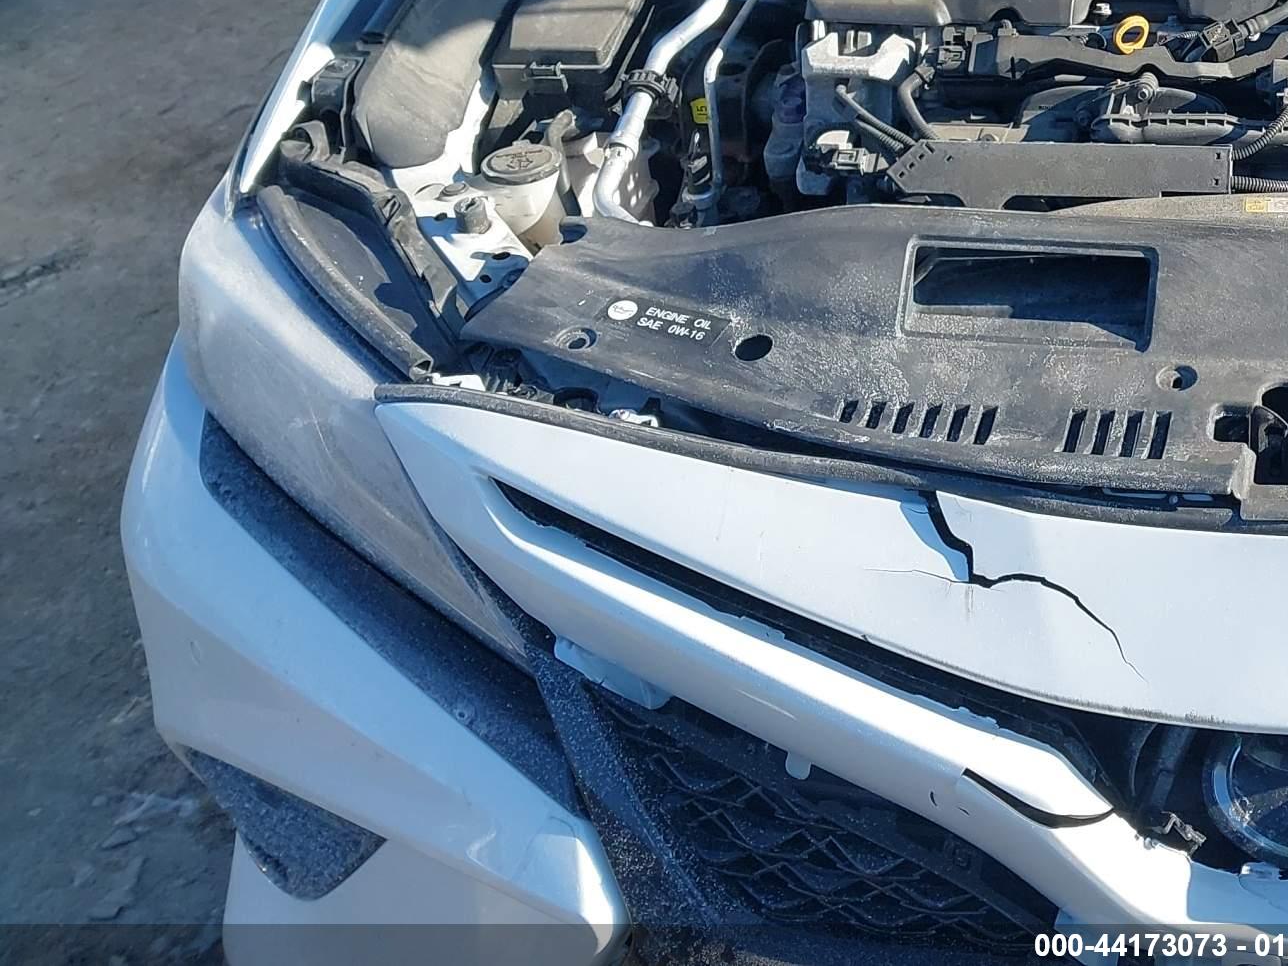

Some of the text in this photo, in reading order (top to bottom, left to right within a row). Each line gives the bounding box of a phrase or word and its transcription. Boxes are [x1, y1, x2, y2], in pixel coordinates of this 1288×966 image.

[636, 317, 706, 341] SAE 0W-16
[645, 306, 712, 330] ENGINE OIL
